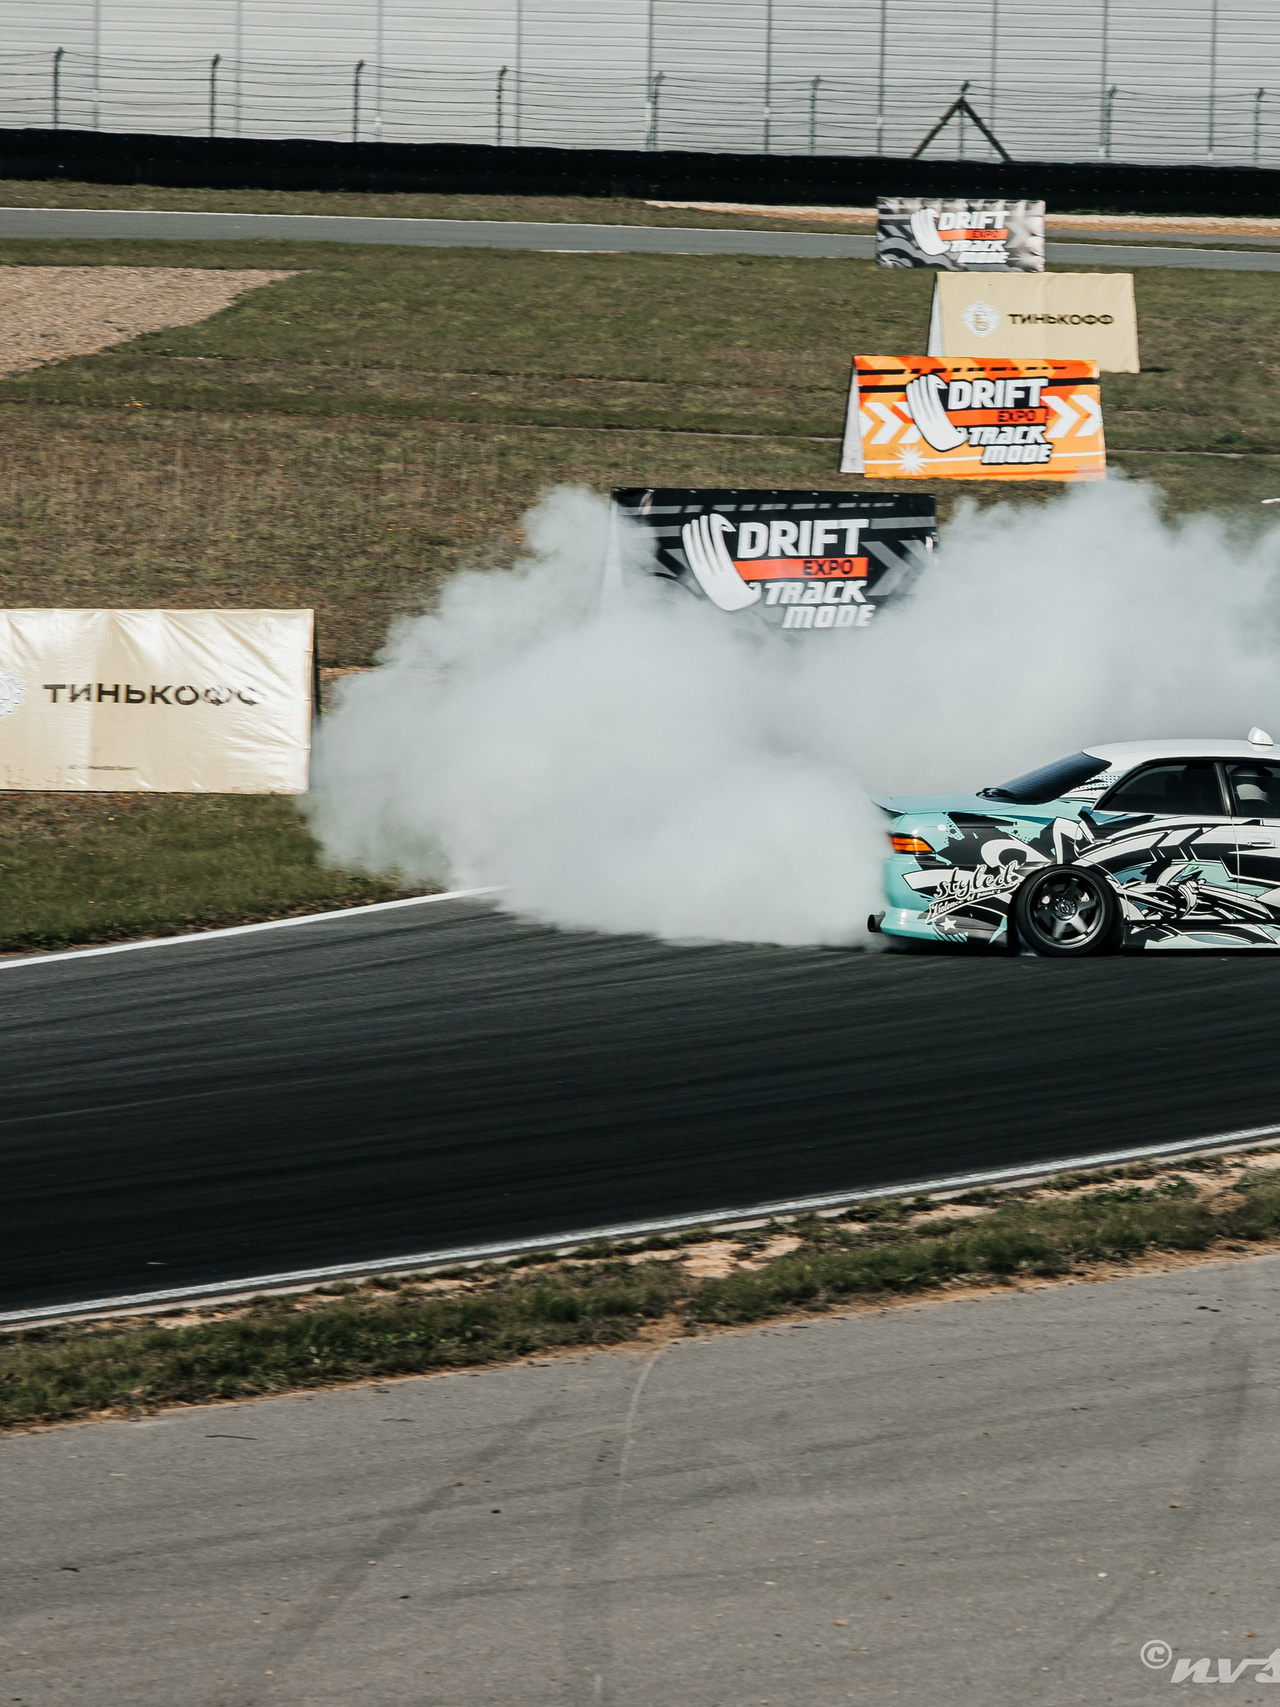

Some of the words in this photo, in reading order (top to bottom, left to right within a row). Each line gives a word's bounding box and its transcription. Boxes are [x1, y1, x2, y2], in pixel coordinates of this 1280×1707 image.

[938, 211, 1010, 231] DRIFT
[972, 230, 999, 239] EXPO
[1008, 313, 1114, 325] ТИНЬКОФФ
[947, 378, 1049, 410] DRIFT
[998, 410, 1036, 422] EXPO
[737, 519, 869, 559] DRIFT
[803, 559, 854, 576] EXPO
[934, 860, 1018, 900] styled
